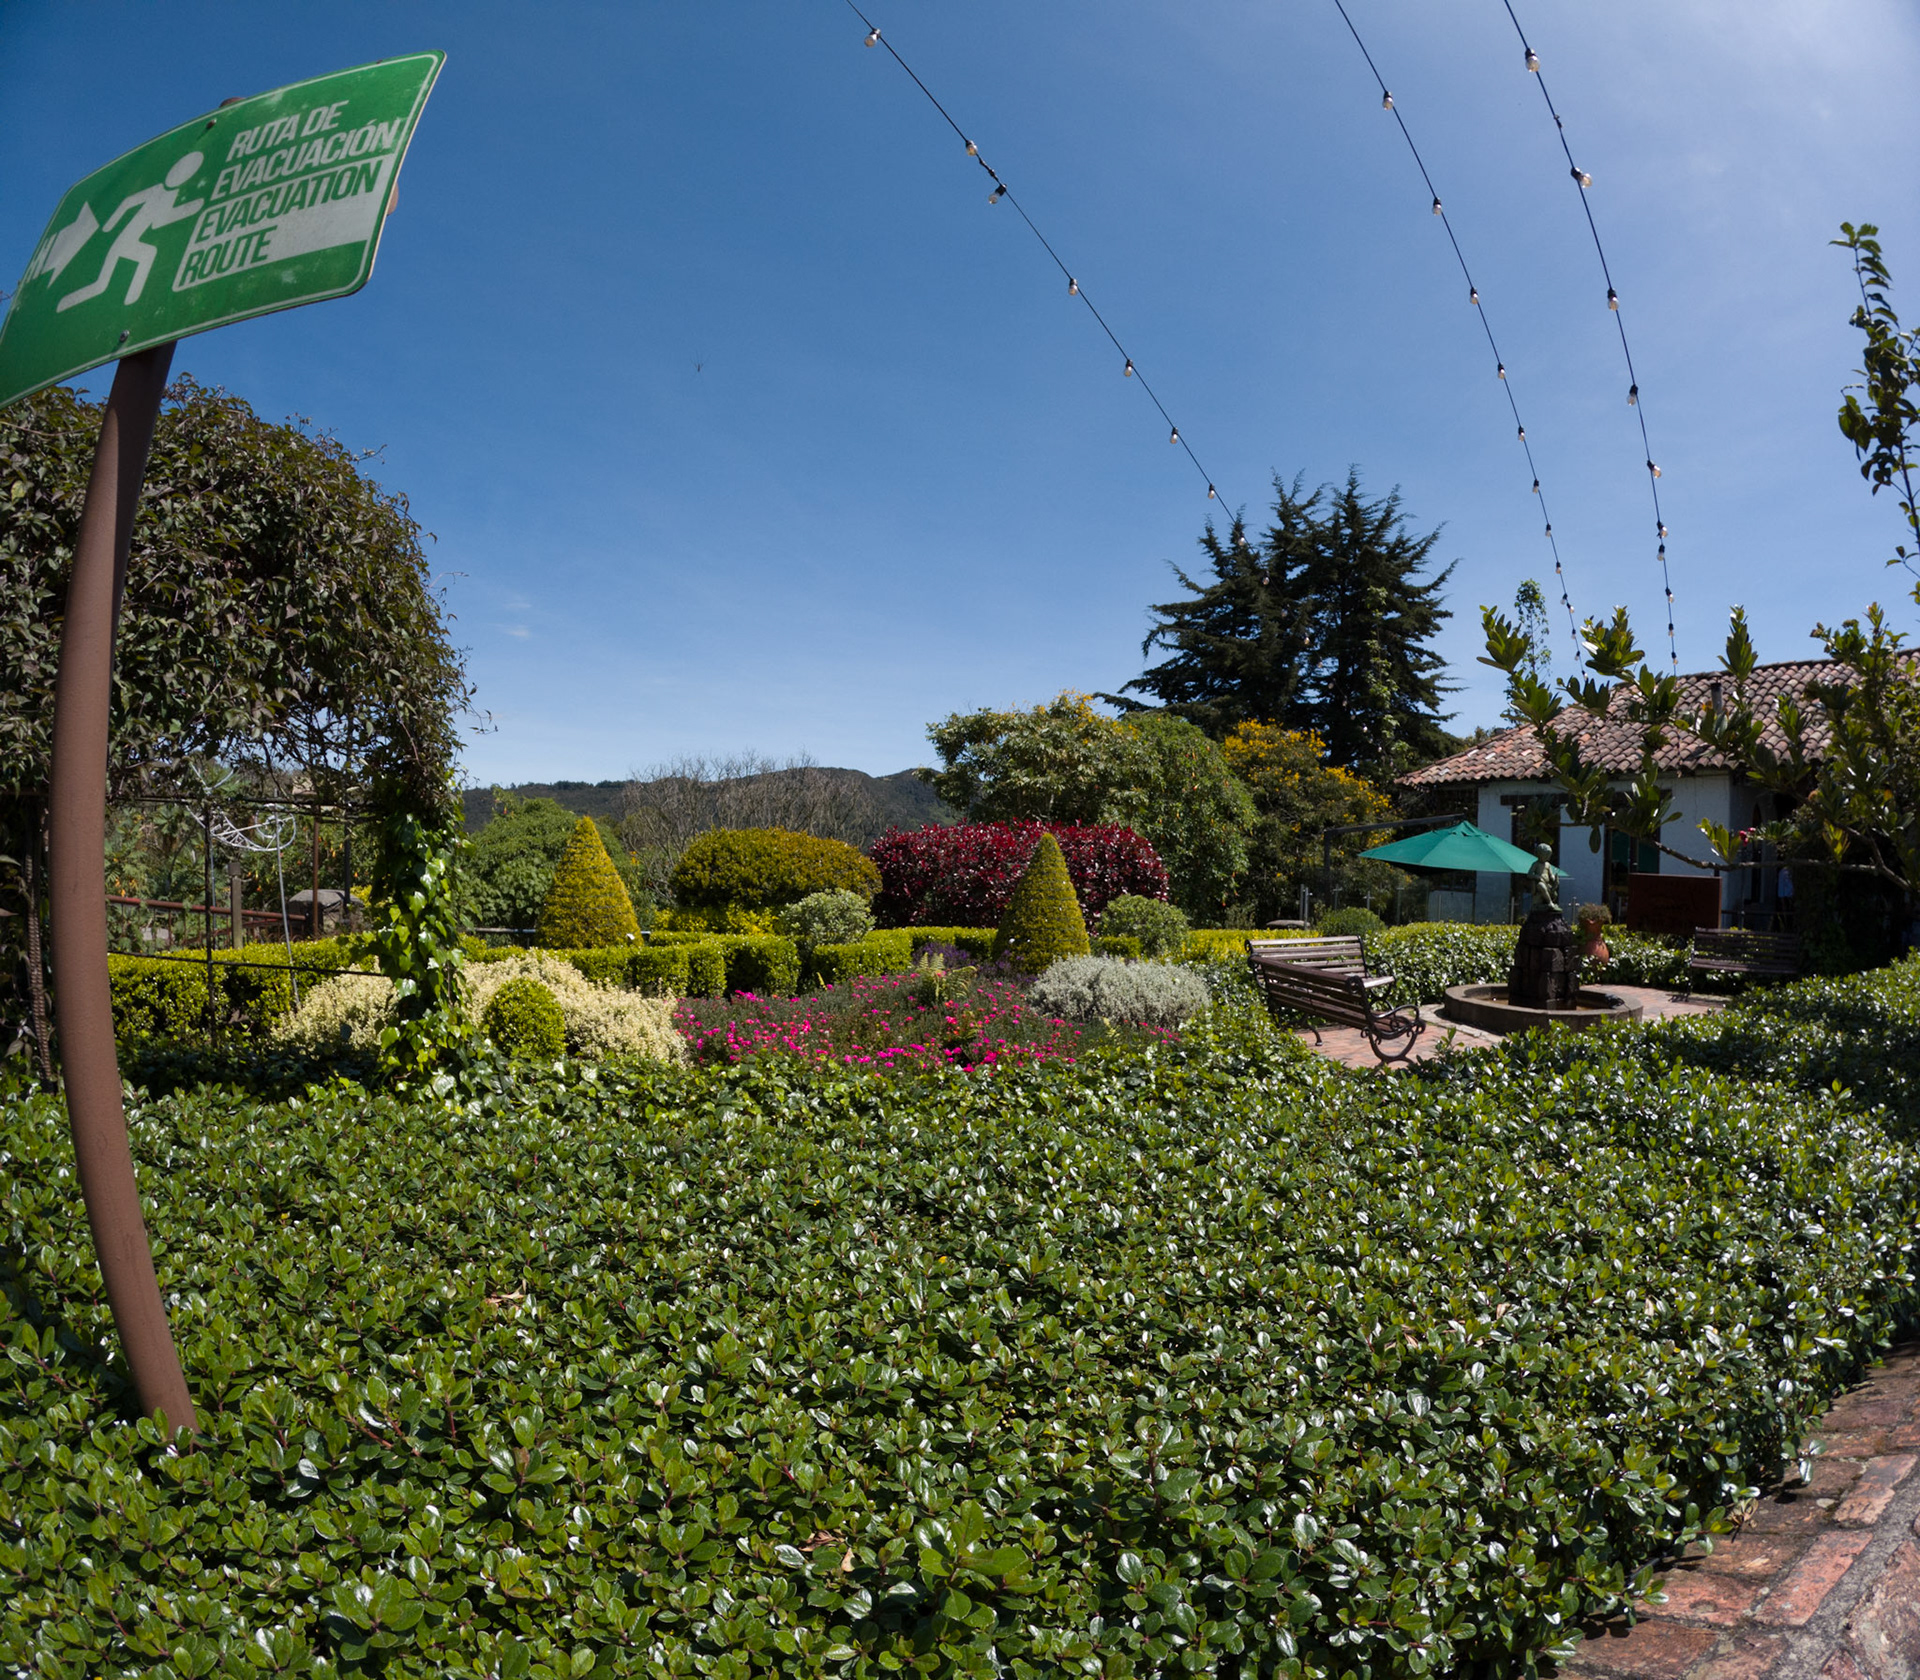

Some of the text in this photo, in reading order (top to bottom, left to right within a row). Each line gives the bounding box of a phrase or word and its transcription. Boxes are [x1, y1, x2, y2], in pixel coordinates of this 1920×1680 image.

[210, 119, 402, 201] EVACUACIÓN
[225, 100, 349, 162] RUTA DE
[194, 159, 383, 244] EVACUATION
[178, 225, 278, 287] ROUTE
